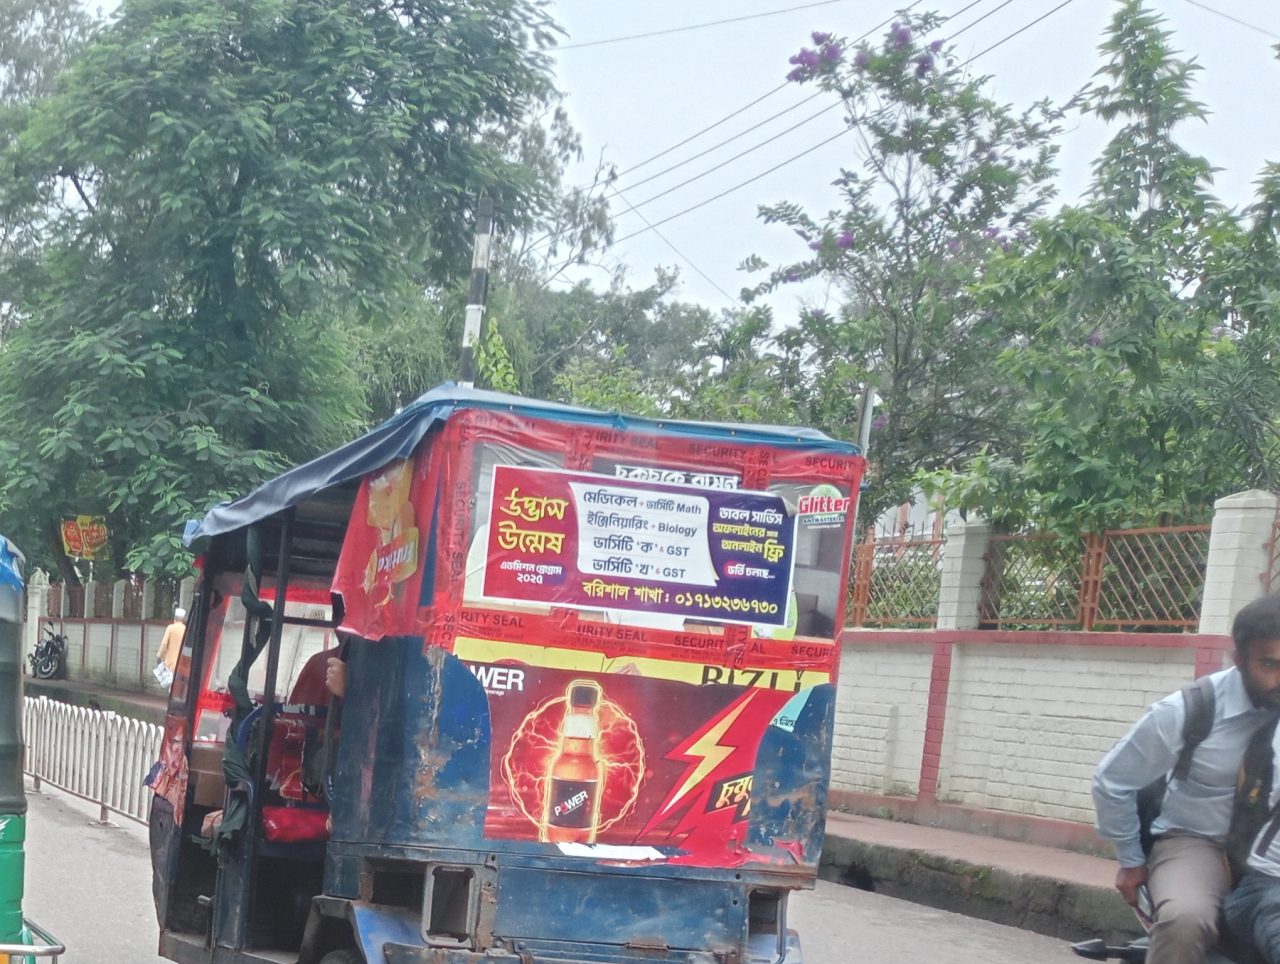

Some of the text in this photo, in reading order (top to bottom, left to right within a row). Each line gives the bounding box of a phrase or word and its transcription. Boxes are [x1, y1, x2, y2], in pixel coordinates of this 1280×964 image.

[499, 487, 569, 521] উদ্ভাস
[583, 489, 638, 507] মেডিকেল
[646, 498, 675, 511] ভার্সিটি
[676, 503, 701, 515] Math
[799, 495, 850, 514] Glitter
[719, 507, 783, 525] ডাবল সার্ভিস
[498, 520, 565, 554] উন্মেষ
[658, 522, 697, 538] Biology
[712, 523, 766, 538] অফলাইনের
[593, 534, 634, 551] ভার্সিটি
[666, 545, 690, 557] GST
[721, 540, 763, 553] অনলাইন
[592, 556, 633, 573] ভার্সিটি
[662, 567, 686, 579] GST
[516, 573, 543, 584] ২০২৫
[583, 579, 630, 600] বরিশাল
[674, 592, 780, 615] ০১৭১৩২৩৬৭৩০
[492, 612, 526, 629] SEAL
[616, 627, 648, 642] SEAL
[674, 635, 725, 649] SECURIT
[469, 665, 525, 691] WER
[554, 790, 588, 816] POWER
